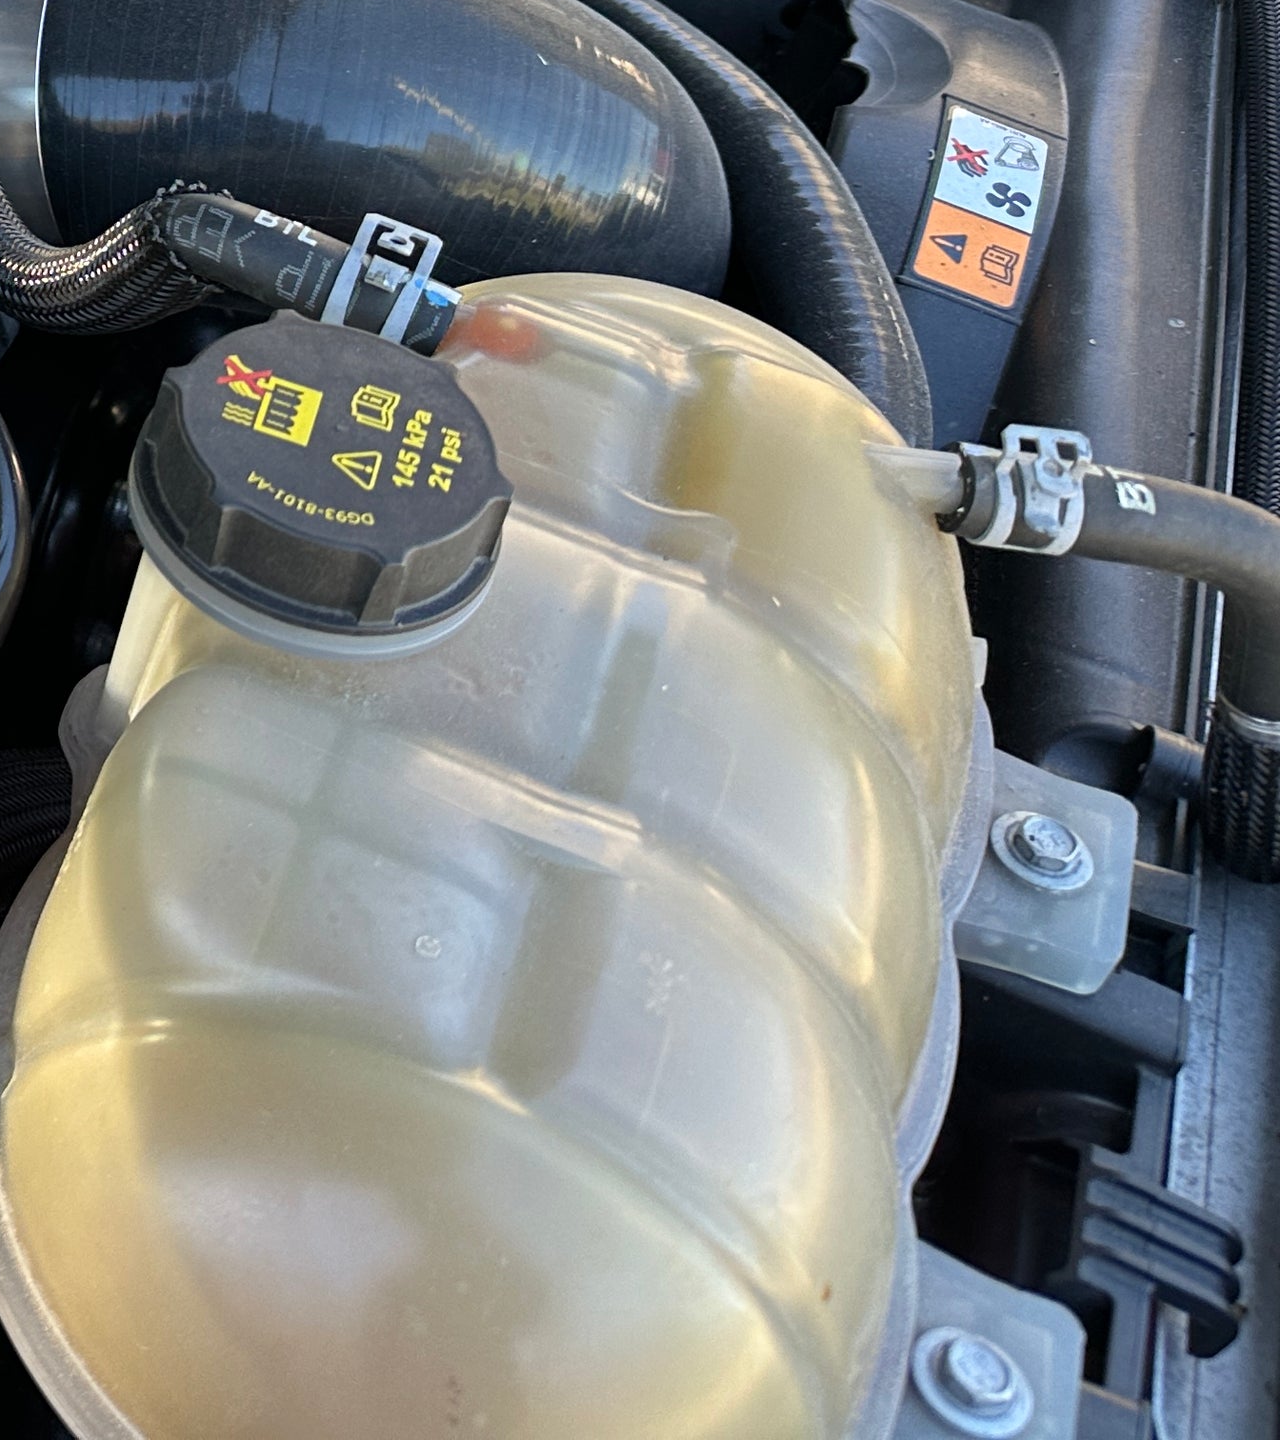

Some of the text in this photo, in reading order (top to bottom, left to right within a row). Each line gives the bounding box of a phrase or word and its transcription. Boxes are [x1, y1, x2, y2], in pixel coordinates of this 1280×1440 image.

[392, 410, 433, 488] 145 kPa
[428, 427, 463, 493] 21 psi
